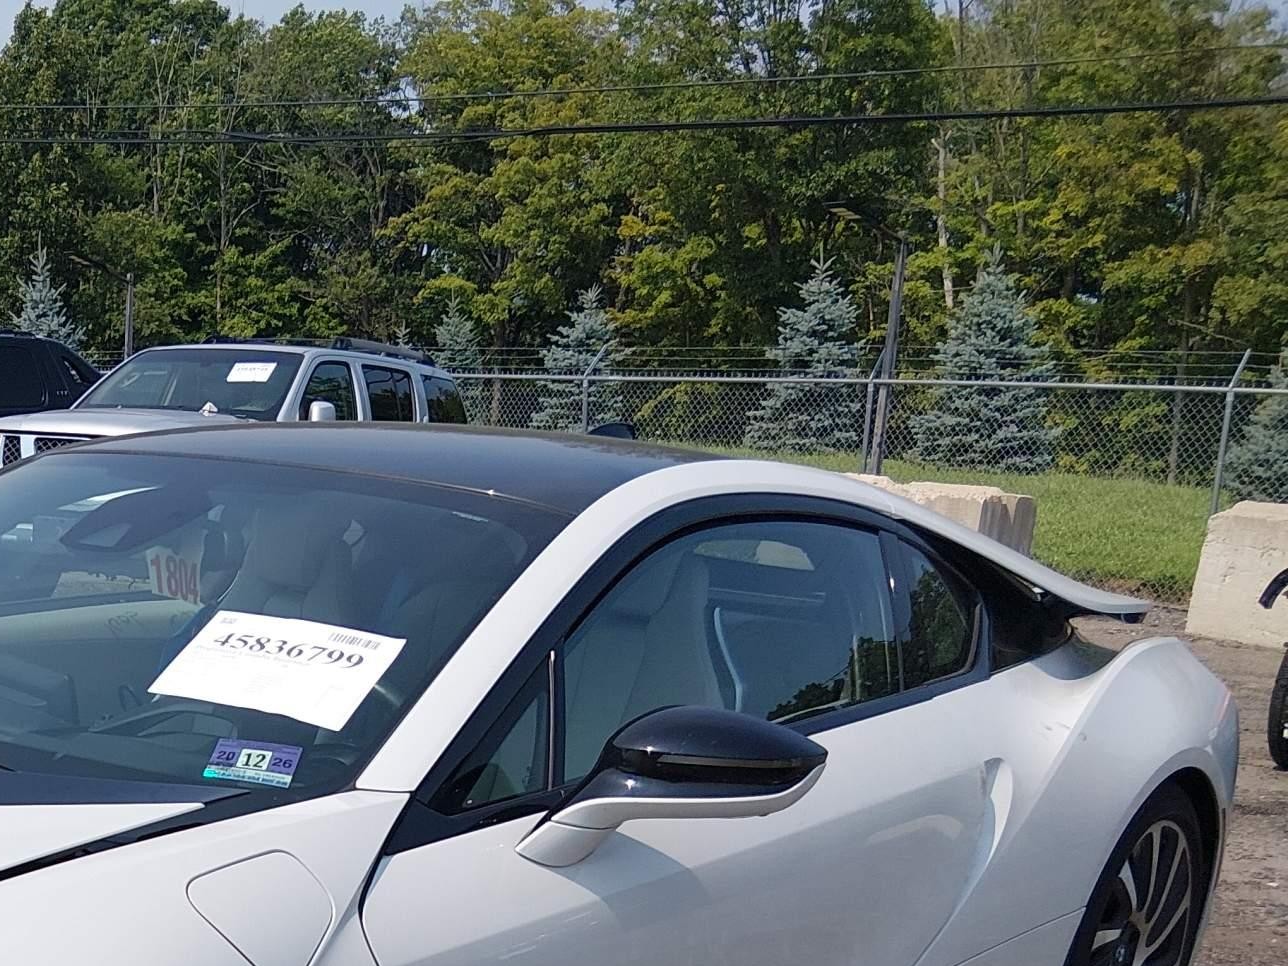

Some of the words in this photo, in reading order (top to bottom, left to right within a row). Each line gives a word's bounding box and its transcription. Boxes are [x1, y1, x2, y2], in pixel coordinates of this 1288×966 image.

[214, 632, 364, 668] 45836799
[217, 750, 236, 761] 20
[242, 752, 267, 768] 12
[272, 757, 293, 769] 26
